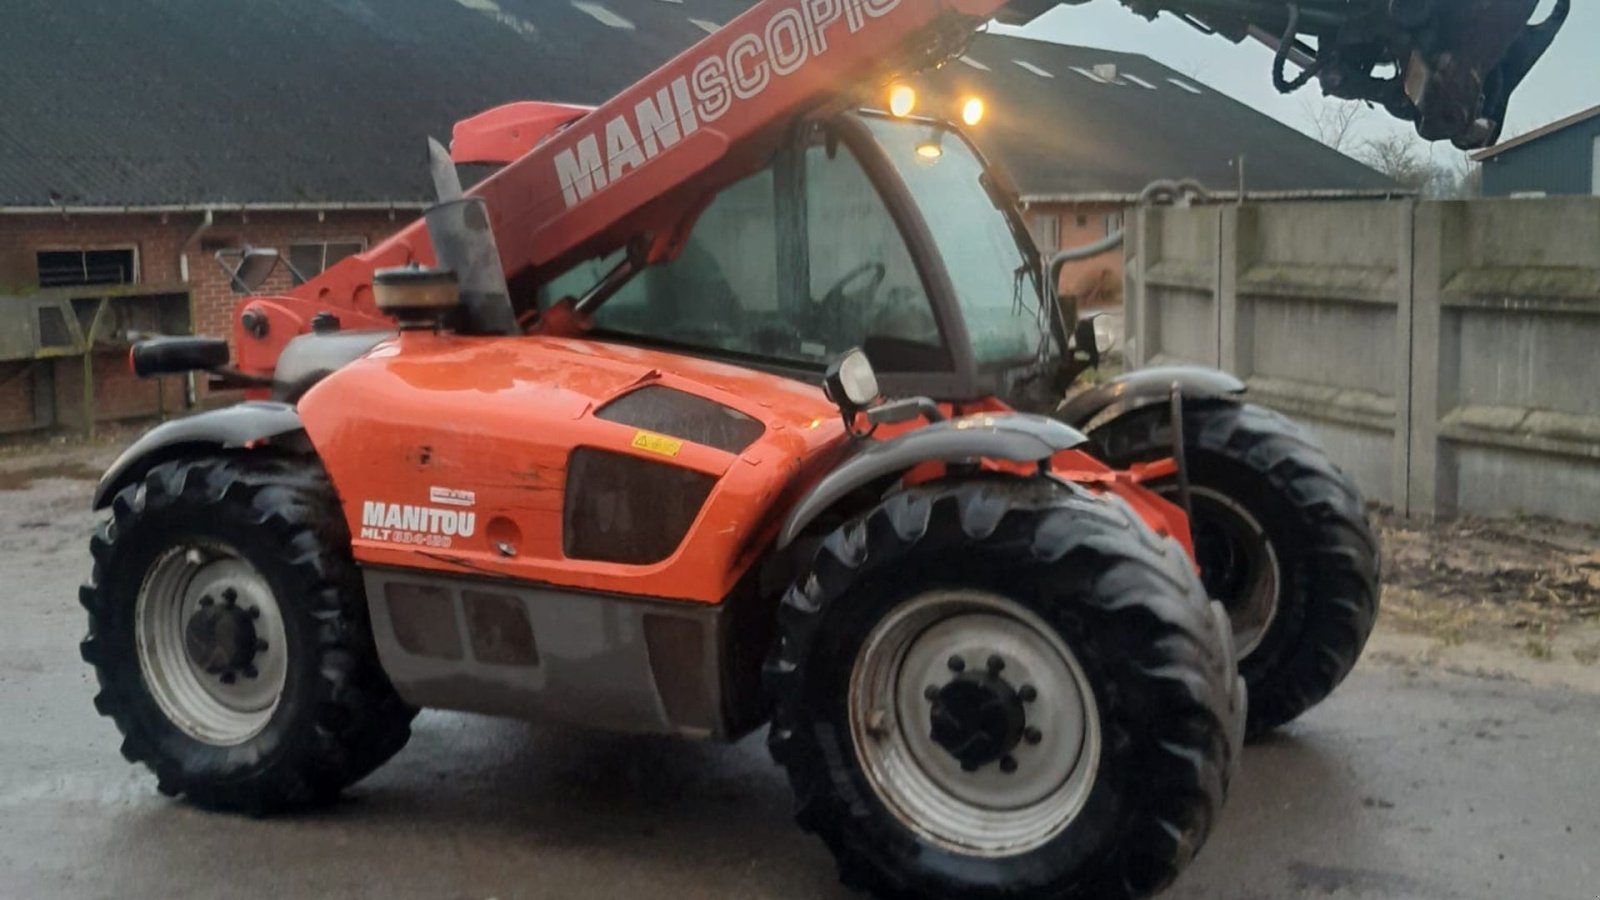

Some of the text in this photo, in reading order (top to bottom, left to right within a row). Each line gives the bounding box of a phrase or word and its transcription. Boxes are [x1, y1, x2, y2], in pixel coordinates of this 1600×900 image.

[553, 0, 901, 208] MANISCOPI
[360, 527, 392, 541] MLT
[362, 501, 476, 537] MANITOU
